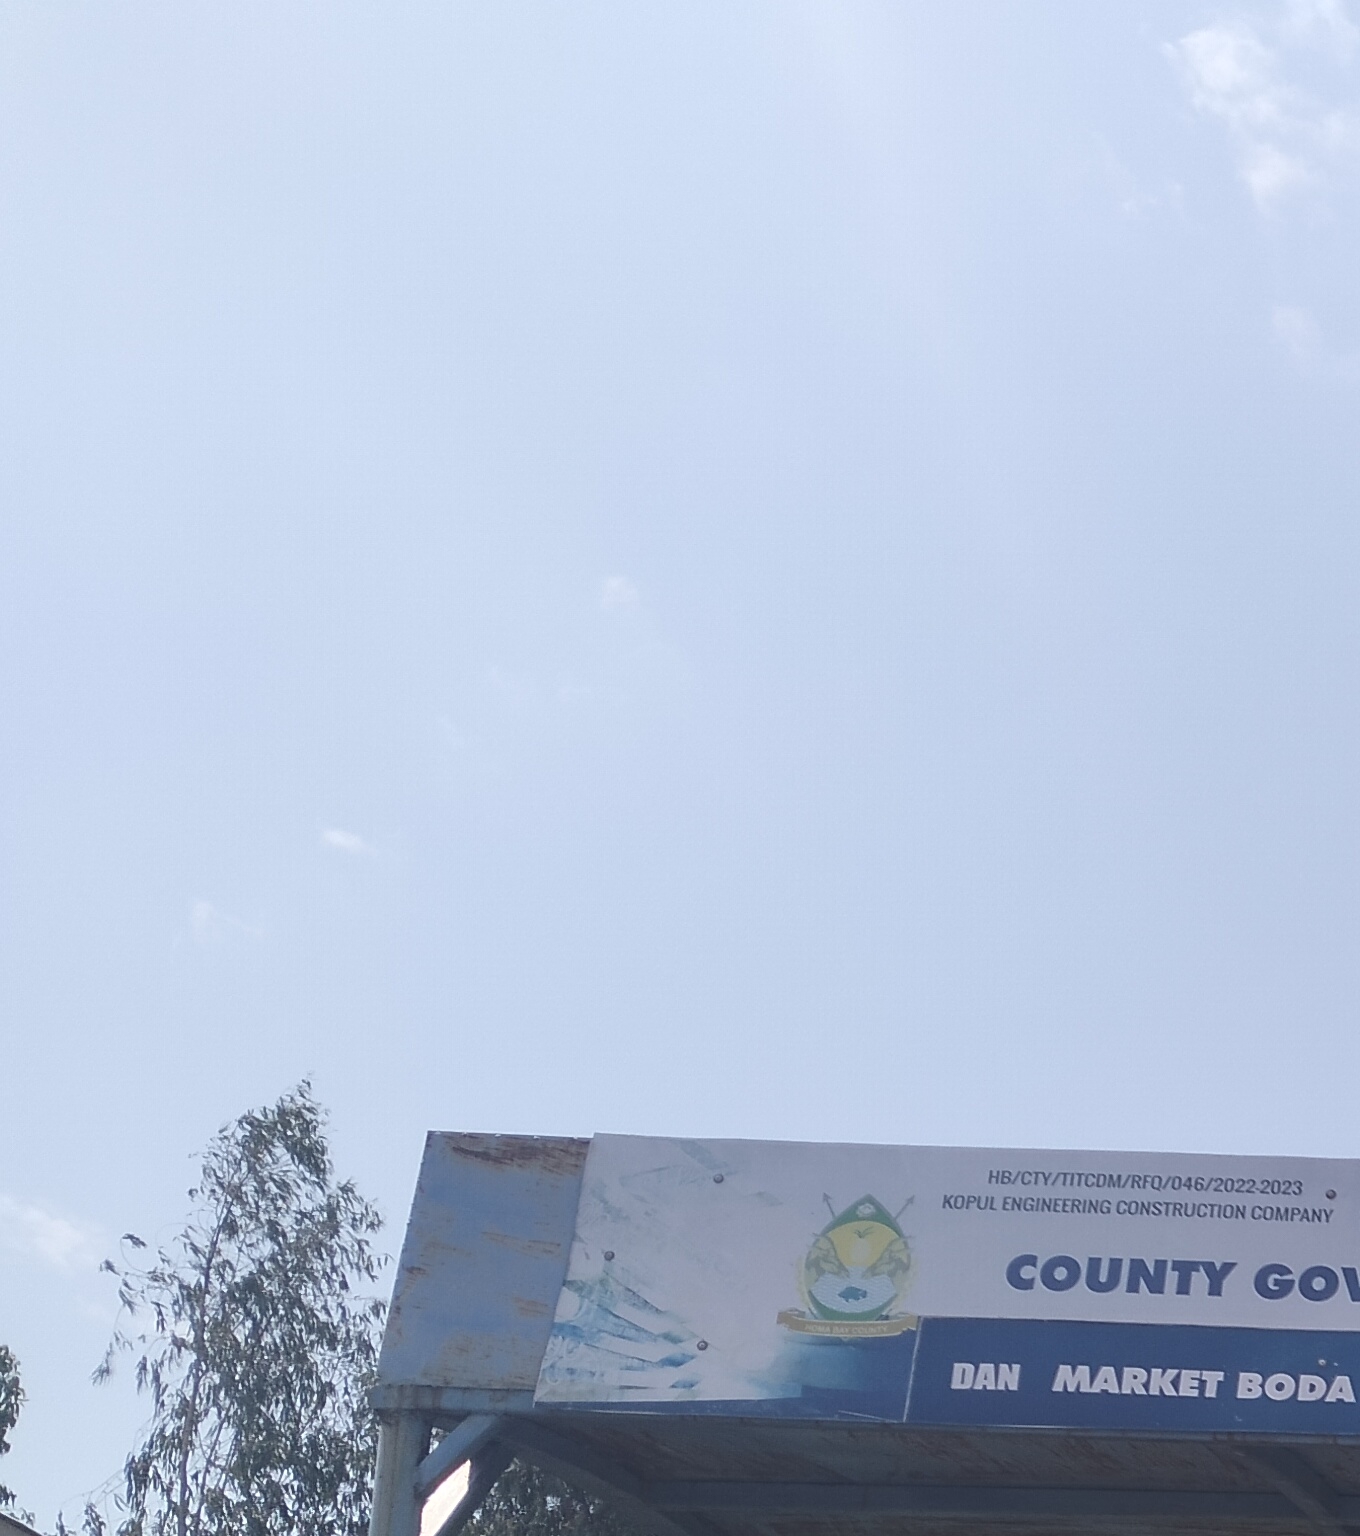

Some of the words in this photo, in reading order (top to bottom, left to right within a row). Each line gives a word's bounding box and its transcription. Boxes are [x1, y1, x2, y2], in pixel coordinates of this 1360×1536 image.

[986, 1169, 1303, 1195] HB/CTY/TITCDM/RFQ/046/2022-2023
[942, 1195, 996, 1210] KOPUL
[1002, 1197, 1111, 1214] ENGINEERING
[1116, 1200, 1246, 1219] CONSTRUCTION
[1251, 1206, 1333, 1223] COMPANY
[1006, 1254, 1237, 1296] COUNTY
[951, 1363, 1020, 1390] DAN
[1052, 1365, 1224, 1397] MARKET
[1237, 1372, 1355, 1402] BODA
